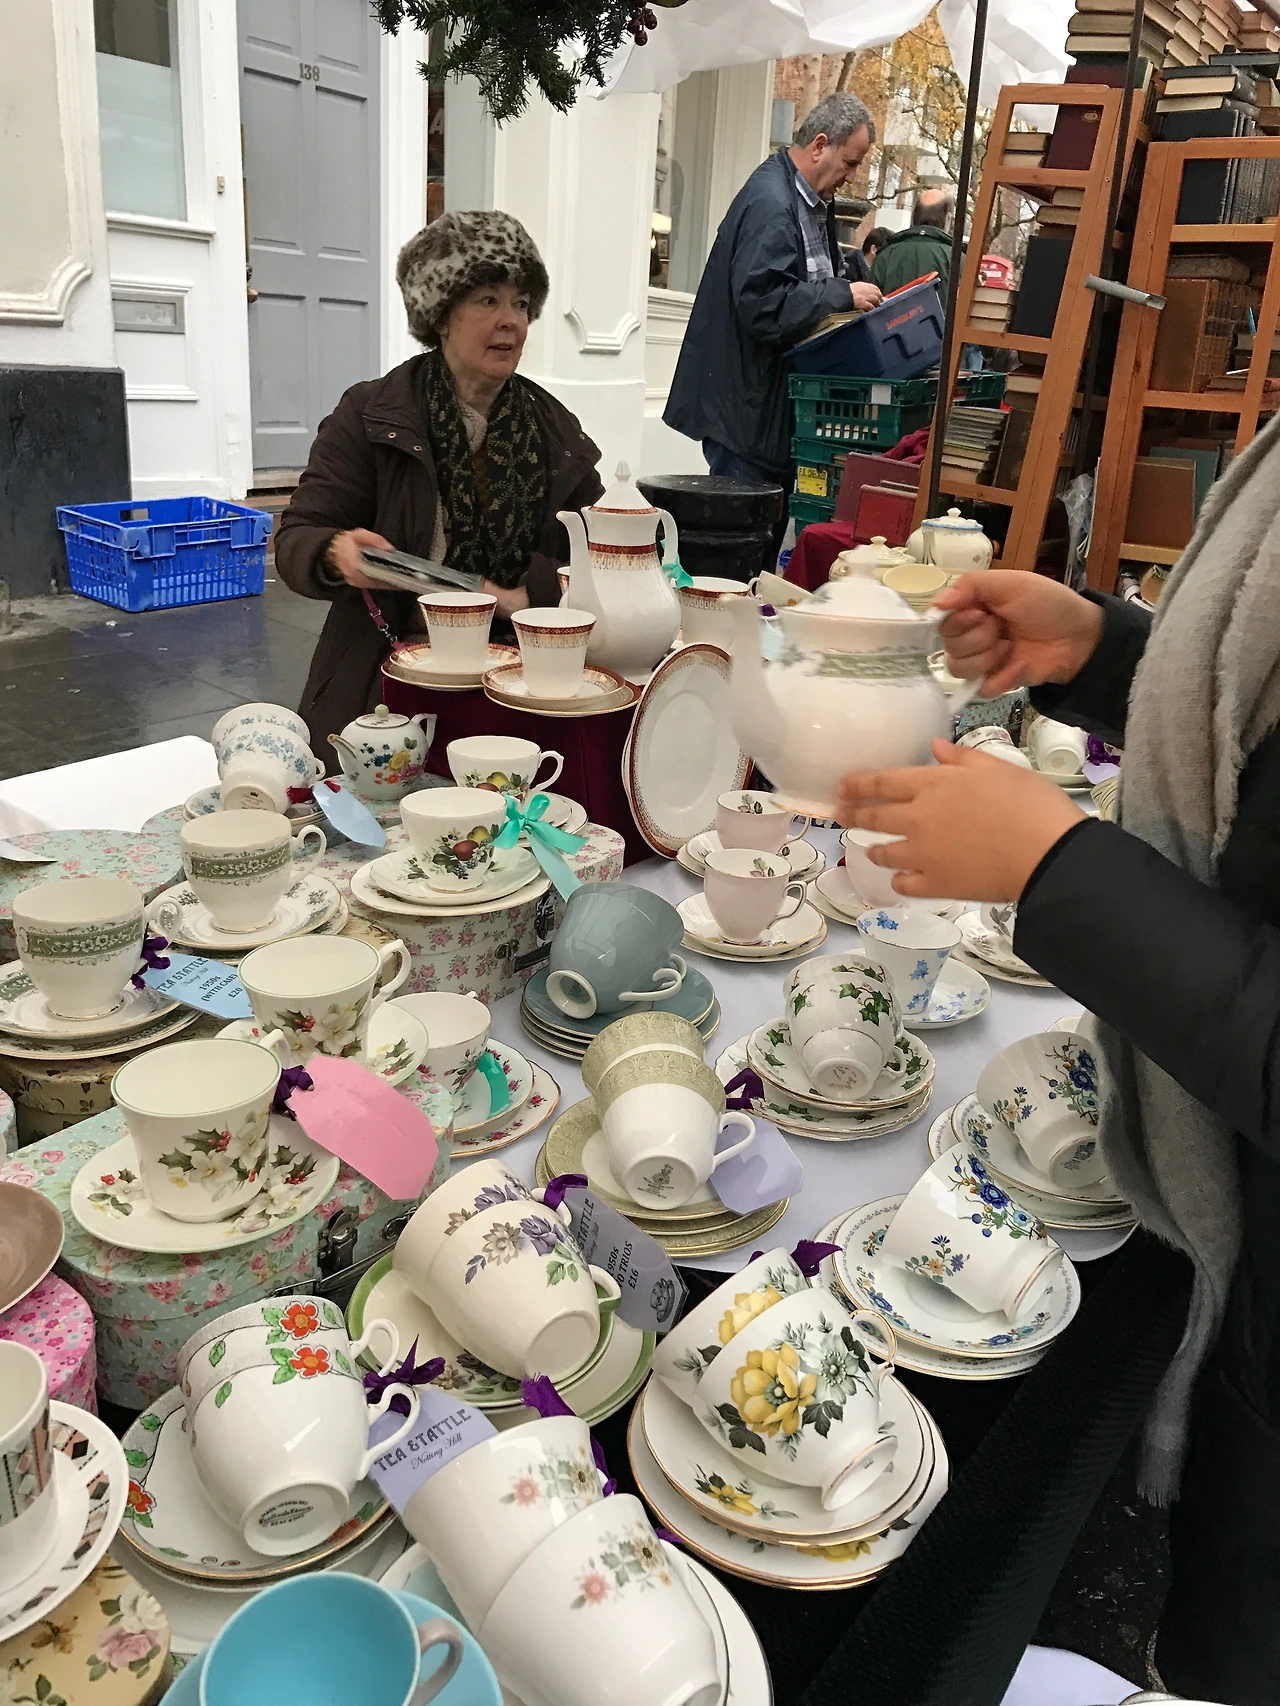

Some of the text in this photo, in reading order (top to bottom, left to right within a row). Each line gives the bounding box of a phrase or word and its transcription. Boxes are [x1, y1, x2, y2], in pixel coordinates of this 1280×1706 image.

[299, 62, 320, 81] 138
[156, 977, 177, 992] TEA
[199, 976, 221, 991] 1950s
[228, 987, 243, 998] £20
[619, 1240, 633, 1272] TRIOS
[628, 1268, 639, 1290] £16
[374, 1447, 408, 1472] TEA
[411, 1432, 463, 1470] Notting Hill
